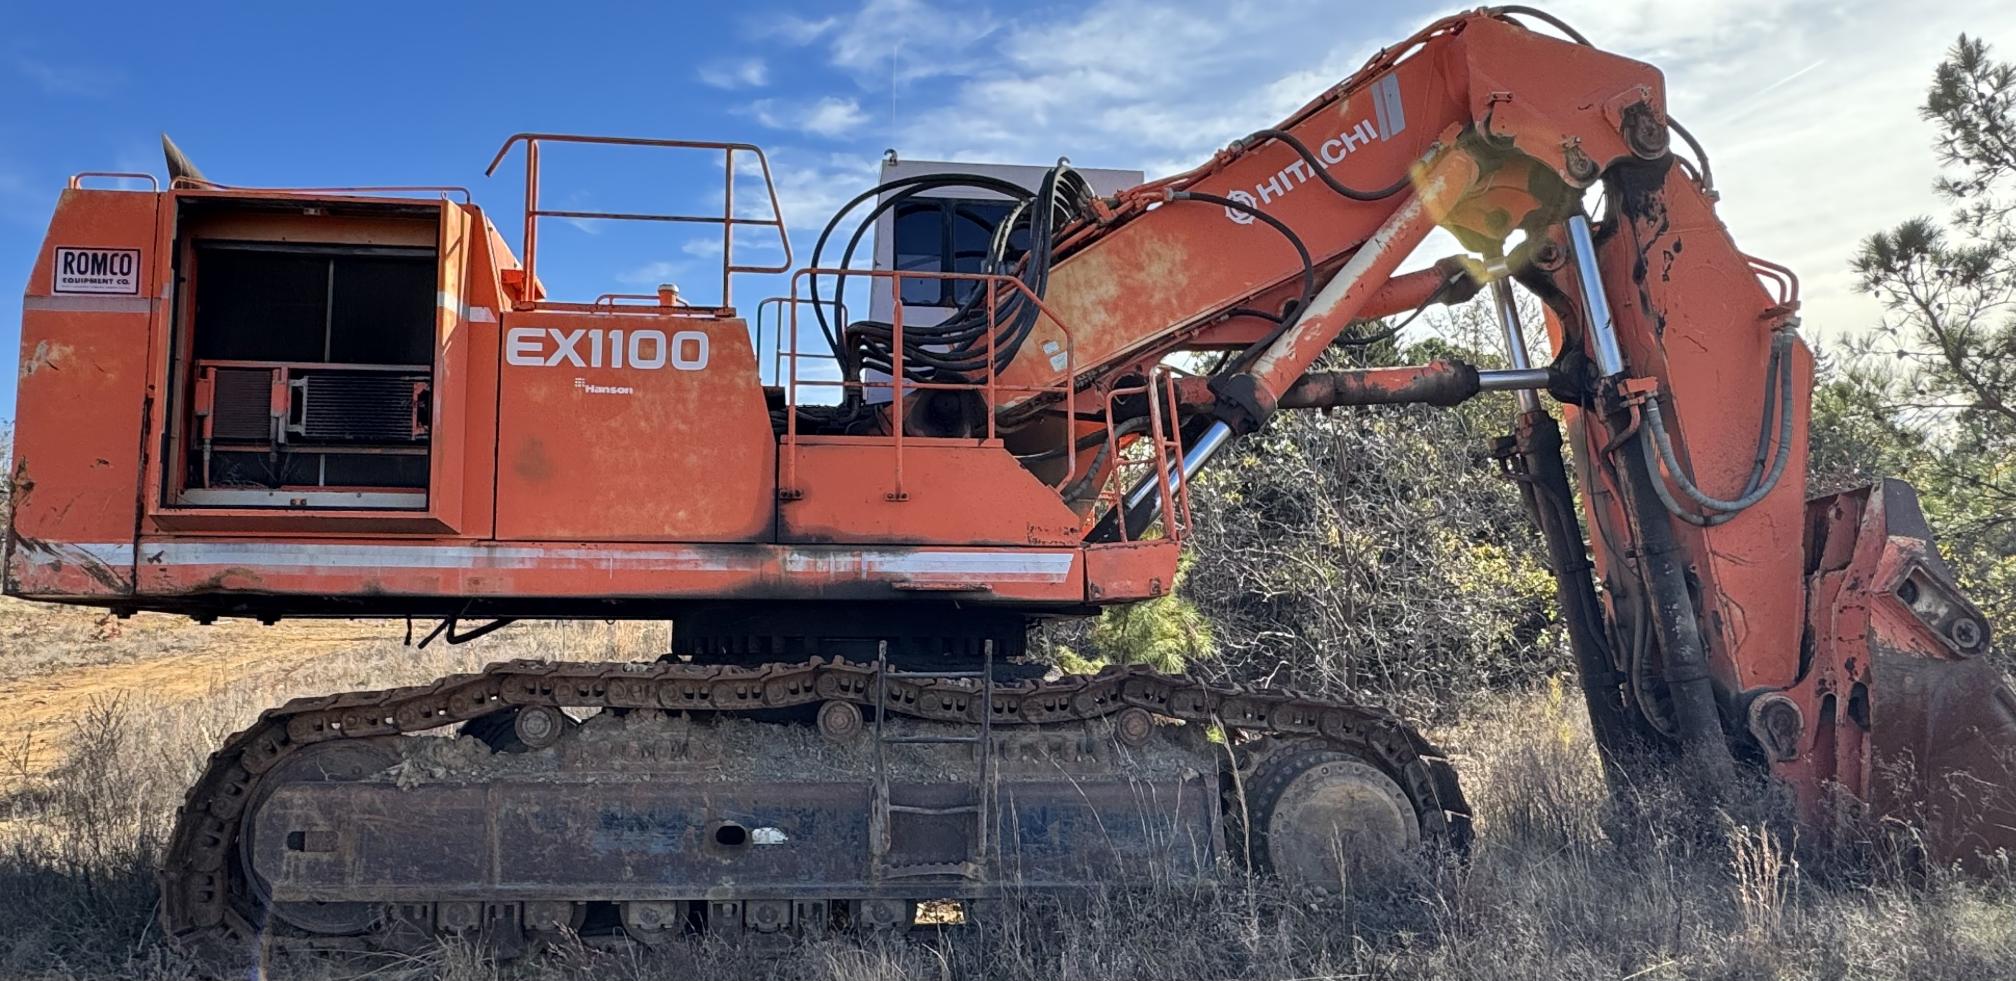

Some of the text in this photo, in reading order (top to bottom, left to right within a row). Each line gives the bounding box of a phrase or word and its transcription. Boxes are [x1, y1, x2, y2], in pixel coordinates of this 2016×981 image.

[63, 251, 132, 276] ROMCO
[62, 277, 113, 285] EQUIPMENT
[506, 327, 710, 371] EX1100
[584, 384, 634, 394] Hanson
